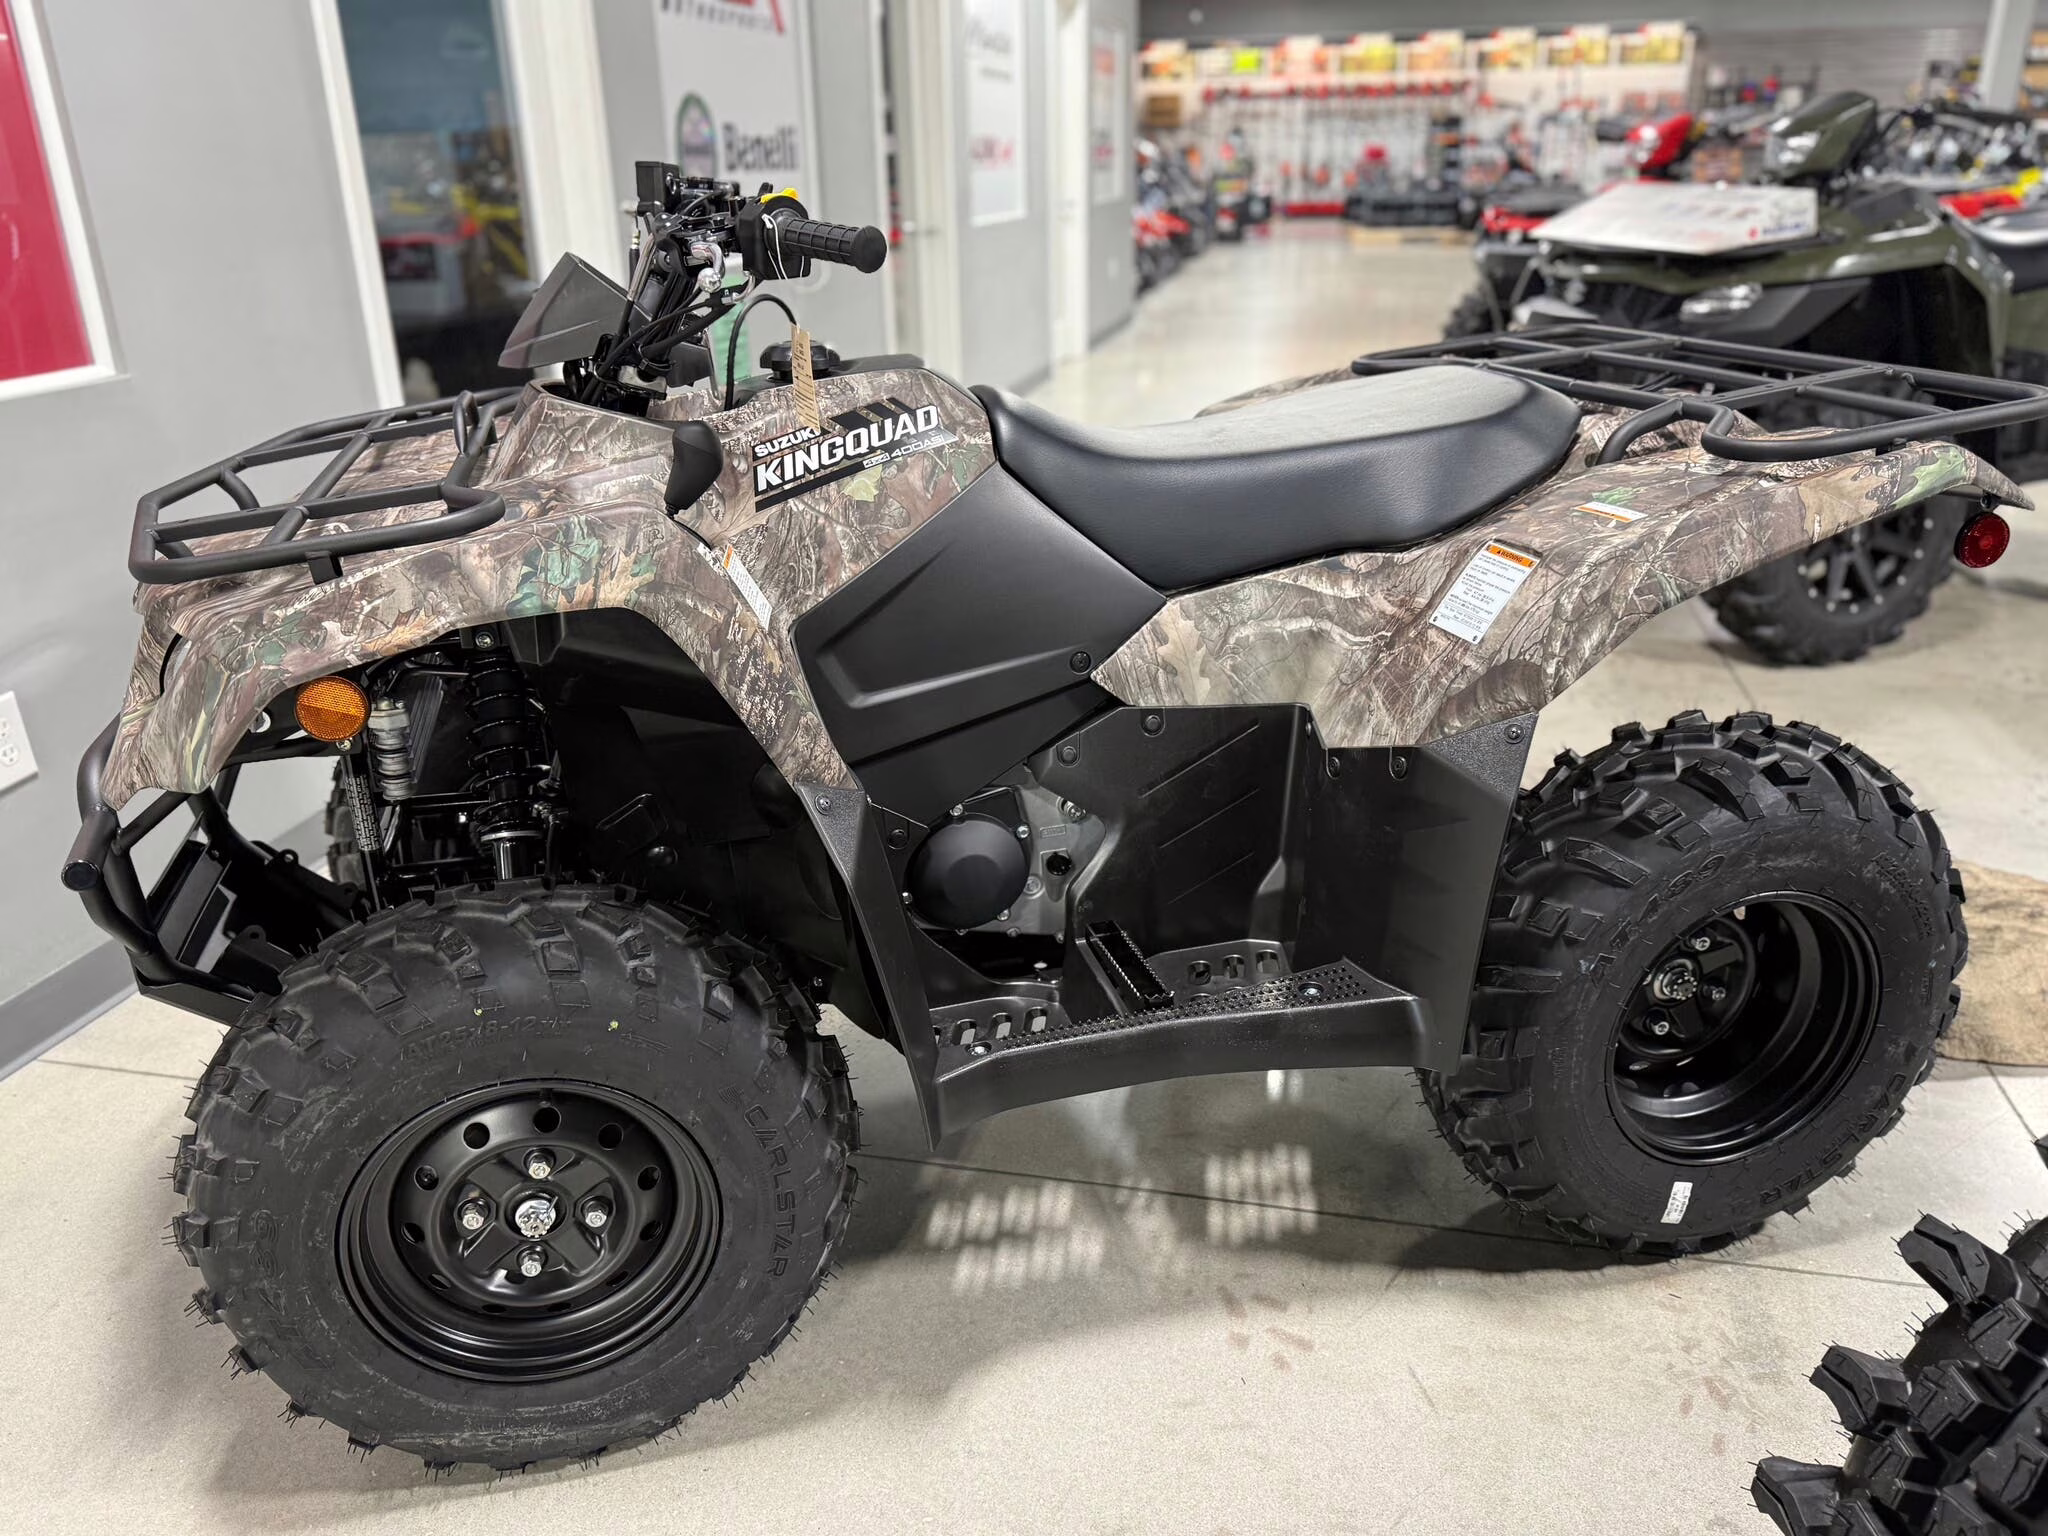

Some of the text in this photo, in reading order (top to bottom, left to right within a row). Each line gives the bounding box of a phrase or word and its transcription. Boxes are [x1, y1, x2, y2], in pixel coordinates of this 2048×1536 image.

[722, 122, 799, 171] Benelli
[757, 405, 939, 492] KINGQUAD
[743, 1103, 796, 1277] CARLSTAR
[1759, 1072, 1907, 1205] CARLSTAR
